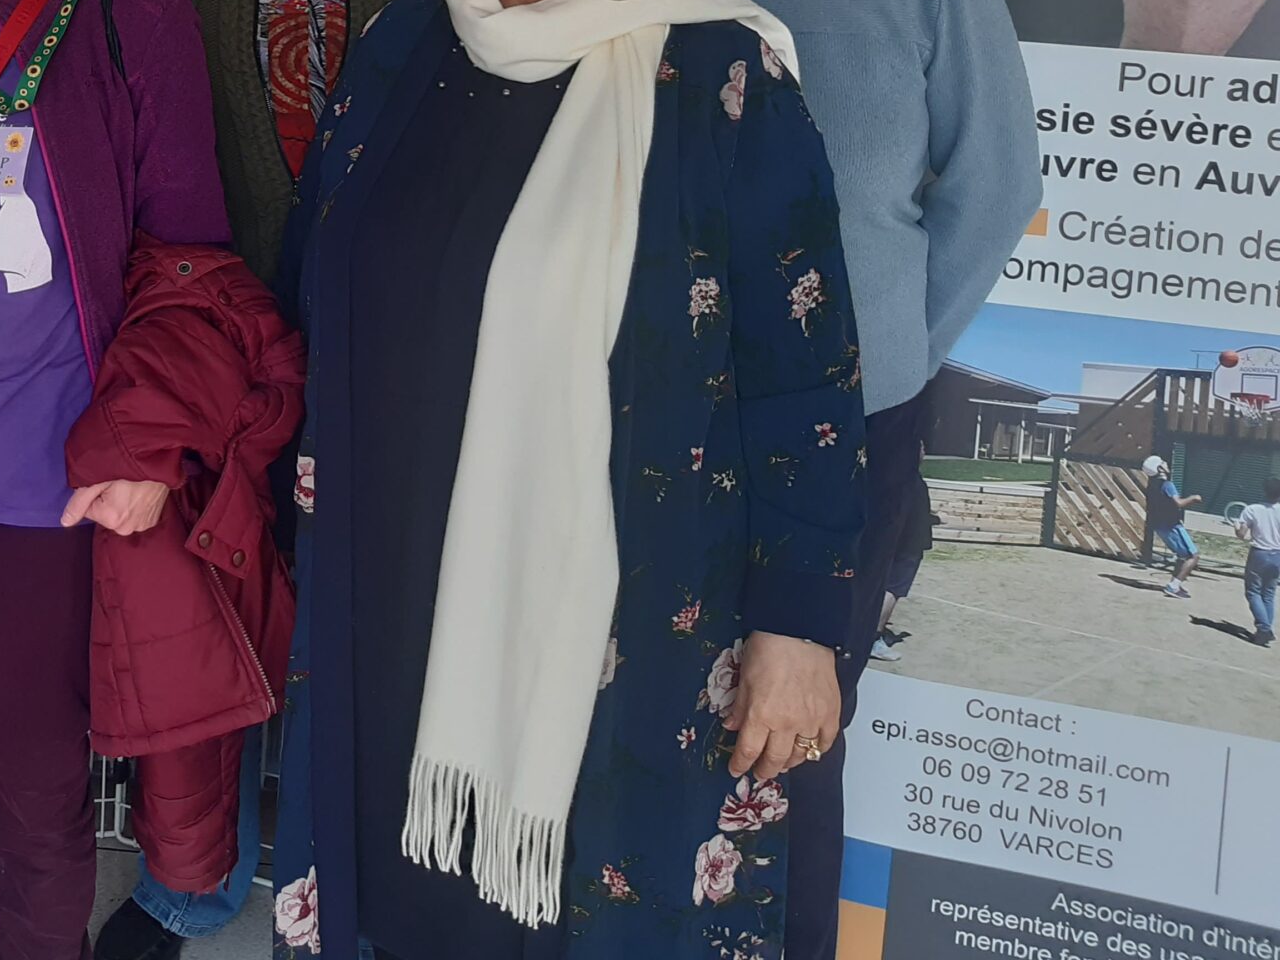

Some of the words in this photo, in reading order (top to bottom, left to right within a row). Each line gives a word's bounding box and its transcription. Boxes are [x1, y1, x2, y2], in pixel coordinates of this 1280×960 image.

[1117, 61, 1215, 99] Pour
[1226, 73, 1280, 104] ad
[1036, 102, 1095, 135] sie
[1108, 108, 1252, 149] sévère
[1133, 161, 1180, 189] en
[1194, 160, 1280, 197] Auv
[1058, 209, 1224, 257] Création
[965, 697, 1062, 733] Contact
[870, 716, 1171, 788] epi.assoc@hotmail.com
[922, 755, 952, 778] 06
[960, 762, 991, 785] 09
[1001, 769, 1029, 792] 72
[1039, 777, 1069, 800] 28
[1078, 784, 1108, 807] 51
[903, 782, 933, 806] 30
[941, 792, 981, 815] rue
[989, 796, 1020, 823] du
[1028, 804, 1123, 842] Nivolon
[907, 811, 983, 844] 38760
[999, 827, 1114, 869] VARCES
[930, 896, 1100, 947] représentative
[1106, 932, 1152, 959] des
[1051, 892, 1194, 941] Association
[954, 928, 1053, 960] membre
